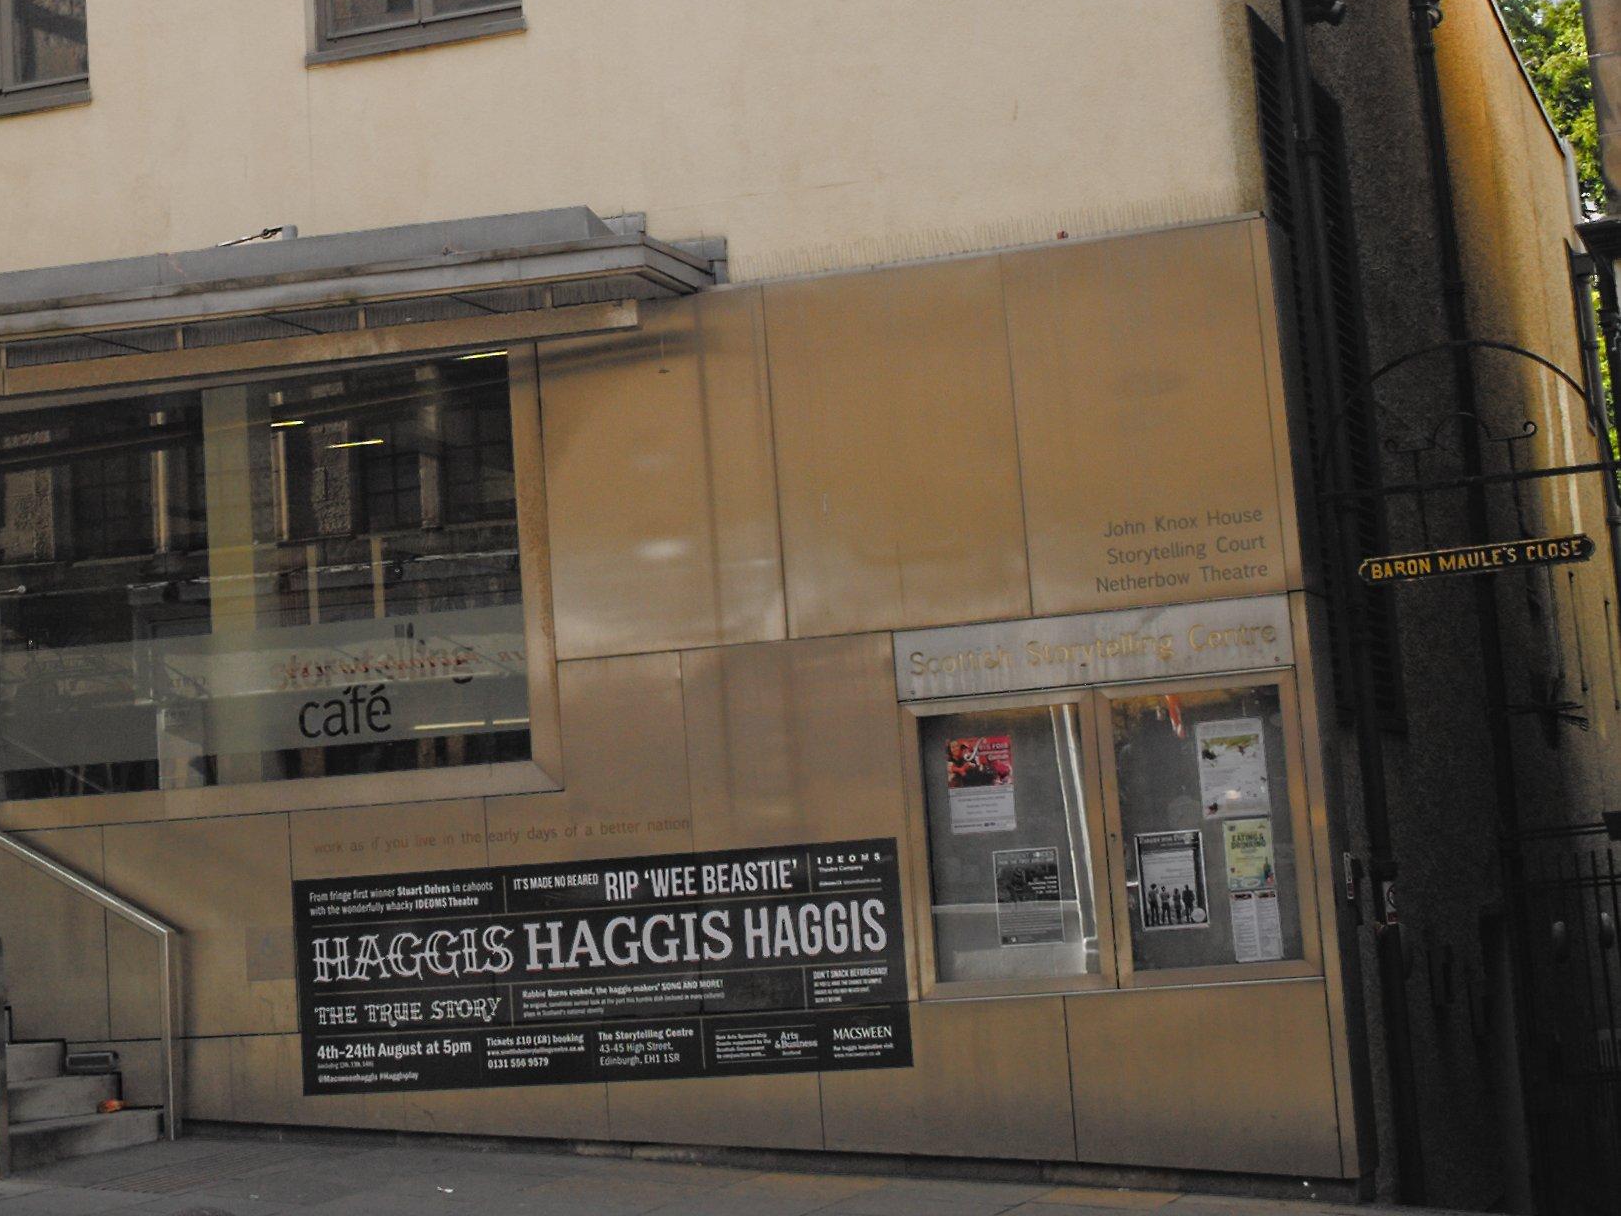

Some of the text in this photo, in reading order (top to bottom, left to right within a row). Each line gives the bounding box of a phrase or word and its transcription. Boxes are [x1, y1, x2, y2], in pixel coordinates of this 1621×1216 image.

[1103, 507, 1264, 539] John Knox House
[1106, 534, 1267, 567] Storytelling Court
[1370, 539, 1583, 580] BARON MAULE'S CLOSE
[1096, 563, 1269, 594] Netherbow Theatre
[909, 623, 1277, 676] Scottish Storytelling Centre
[298, 684, 392, 739] café
[313, 839, 343, 854] work
[350, 840, 365, 853] as
[385, 838, 410, 853] you
[415, 833, 437, 848] live
[442, 832, 455, 846] in
[461, 829, 482, 845] the
[488, 826, 520, 844] early
[527, 825, 558, 843] days
[565, 822, 579, 838] of
[585, 825, 593, 836] a
[600, 820, 639, 836] better
[646, 817, 691, 834] nation
[309, 880, 494, 904] From fringe first winner Stuart Delves in cahoots
[605, 870, 640, 902] RIP
[309, 895, 480, 917] with the wonderfully whacky IDEOMS Theatre
[312, 899, 888, 983] HAGGIS HAGGIS HAGGIS
[314, 1005, 358, 1026] THE
[364, 1001, 424, 1028] TRUE
[430, 997, 502, 1023] STORY
[486, 1036, 515, 1047] Tickets
[515, 1035, 532, 1046] £10
[552, 1033, 584, 1046] booking
[598, 1027, 694, 1042] The Storytelling Centre
[599, 1043, 625, 1054] 43-45
[627, 1042, 645, 1054] High
[832, 1025, 893, 1041] MACSWEEN
[378, 1041, 422, 1059] August
[425, 1041, 440, 1055] at
[442, 1039, 472, 1056] 5pm
[487, 1058, 509, 1070] 0131
[644, 1054, 661, 1065] EH1
[663, 1053, 681, 1064] 1SR
